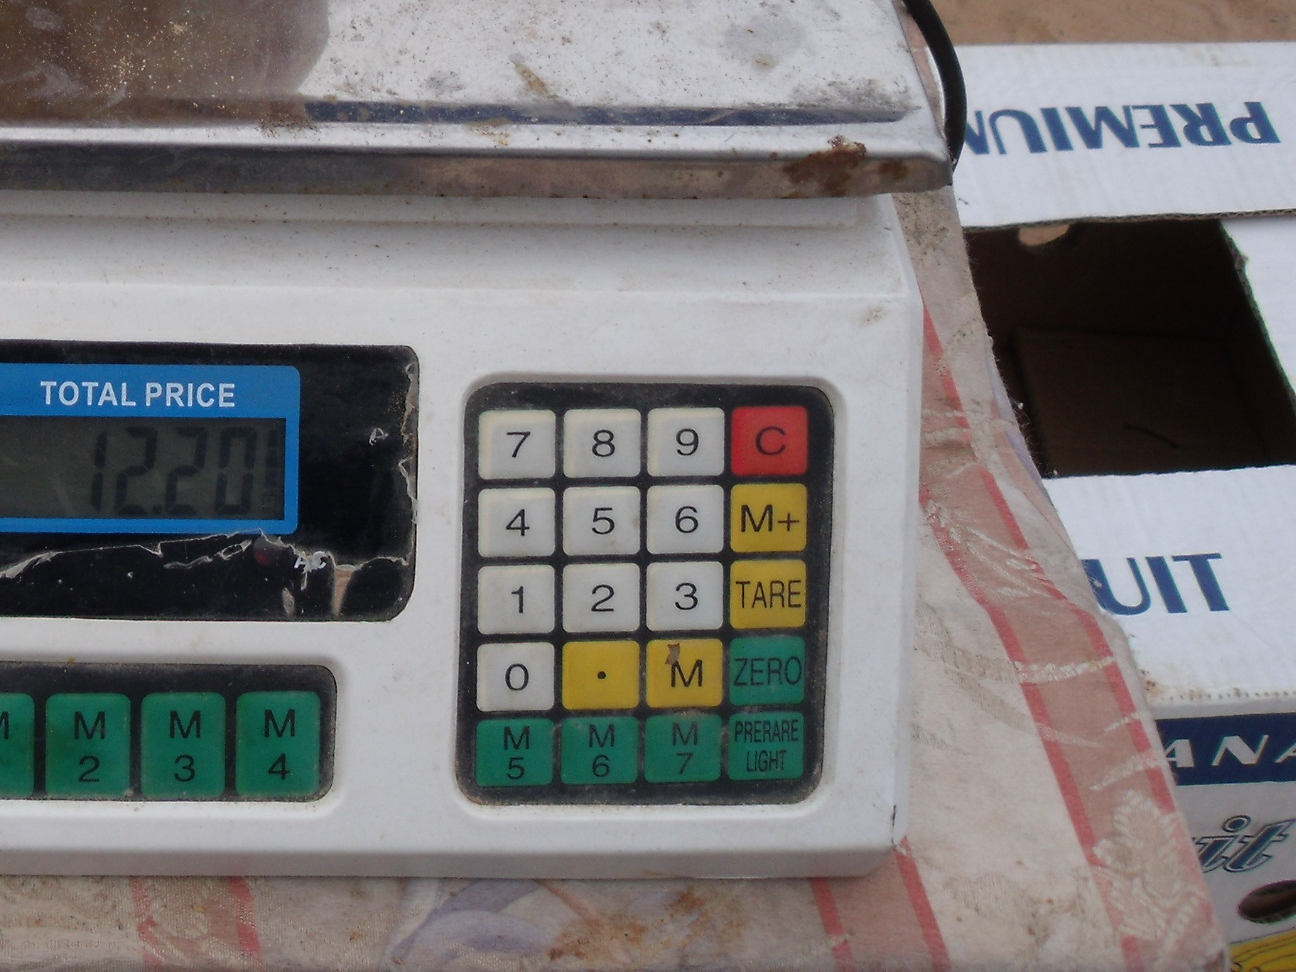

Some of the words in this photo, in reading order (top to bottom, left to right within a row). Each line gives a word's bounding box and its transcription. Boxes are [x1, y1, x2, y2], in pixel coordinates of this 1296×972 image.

[40, 381, 136, 406] TOTAL
[145, 382, 236, 408] PRICE
[507, 431, 531, 458] 7
[591, 429, 616, 457] 8
[676, 428, 699, 456] 9
[755, 427, 786, 456] C
[90, 427, 258, 516] 12.20
[506, 508, 530, 536] 4
[592, 507, 615, 535] 5
[675, 506, 699, 533] 6
[740, 504, 800, 533] M+
[511, 586, 525, 614] 1
[591, 584, 615, 612] 2
[675, 583, 699, 611] 3
[735, 580, 802, 608] TARE
[670, 659, 703, 688] M
[733, 656, 802, 687] ZERO
[74, 711, 105, 739] M
[169, 710, 201, 739] M
[264, 709, 296, 738] M
[503, 725, 530, 750] M
[588, 724, 616, 748] M
[672, 722, 699, 746] M
[79, 757, 101, 782] 2
[174, 755, 196, 782] 3
[268, 753, 290, 781] 4
[507, 757, 525, 779] 5
[592, 755, 610, 777] 6
[676, 753, 694, 775] 7
[746, 749, 786, 772] LIGHT
